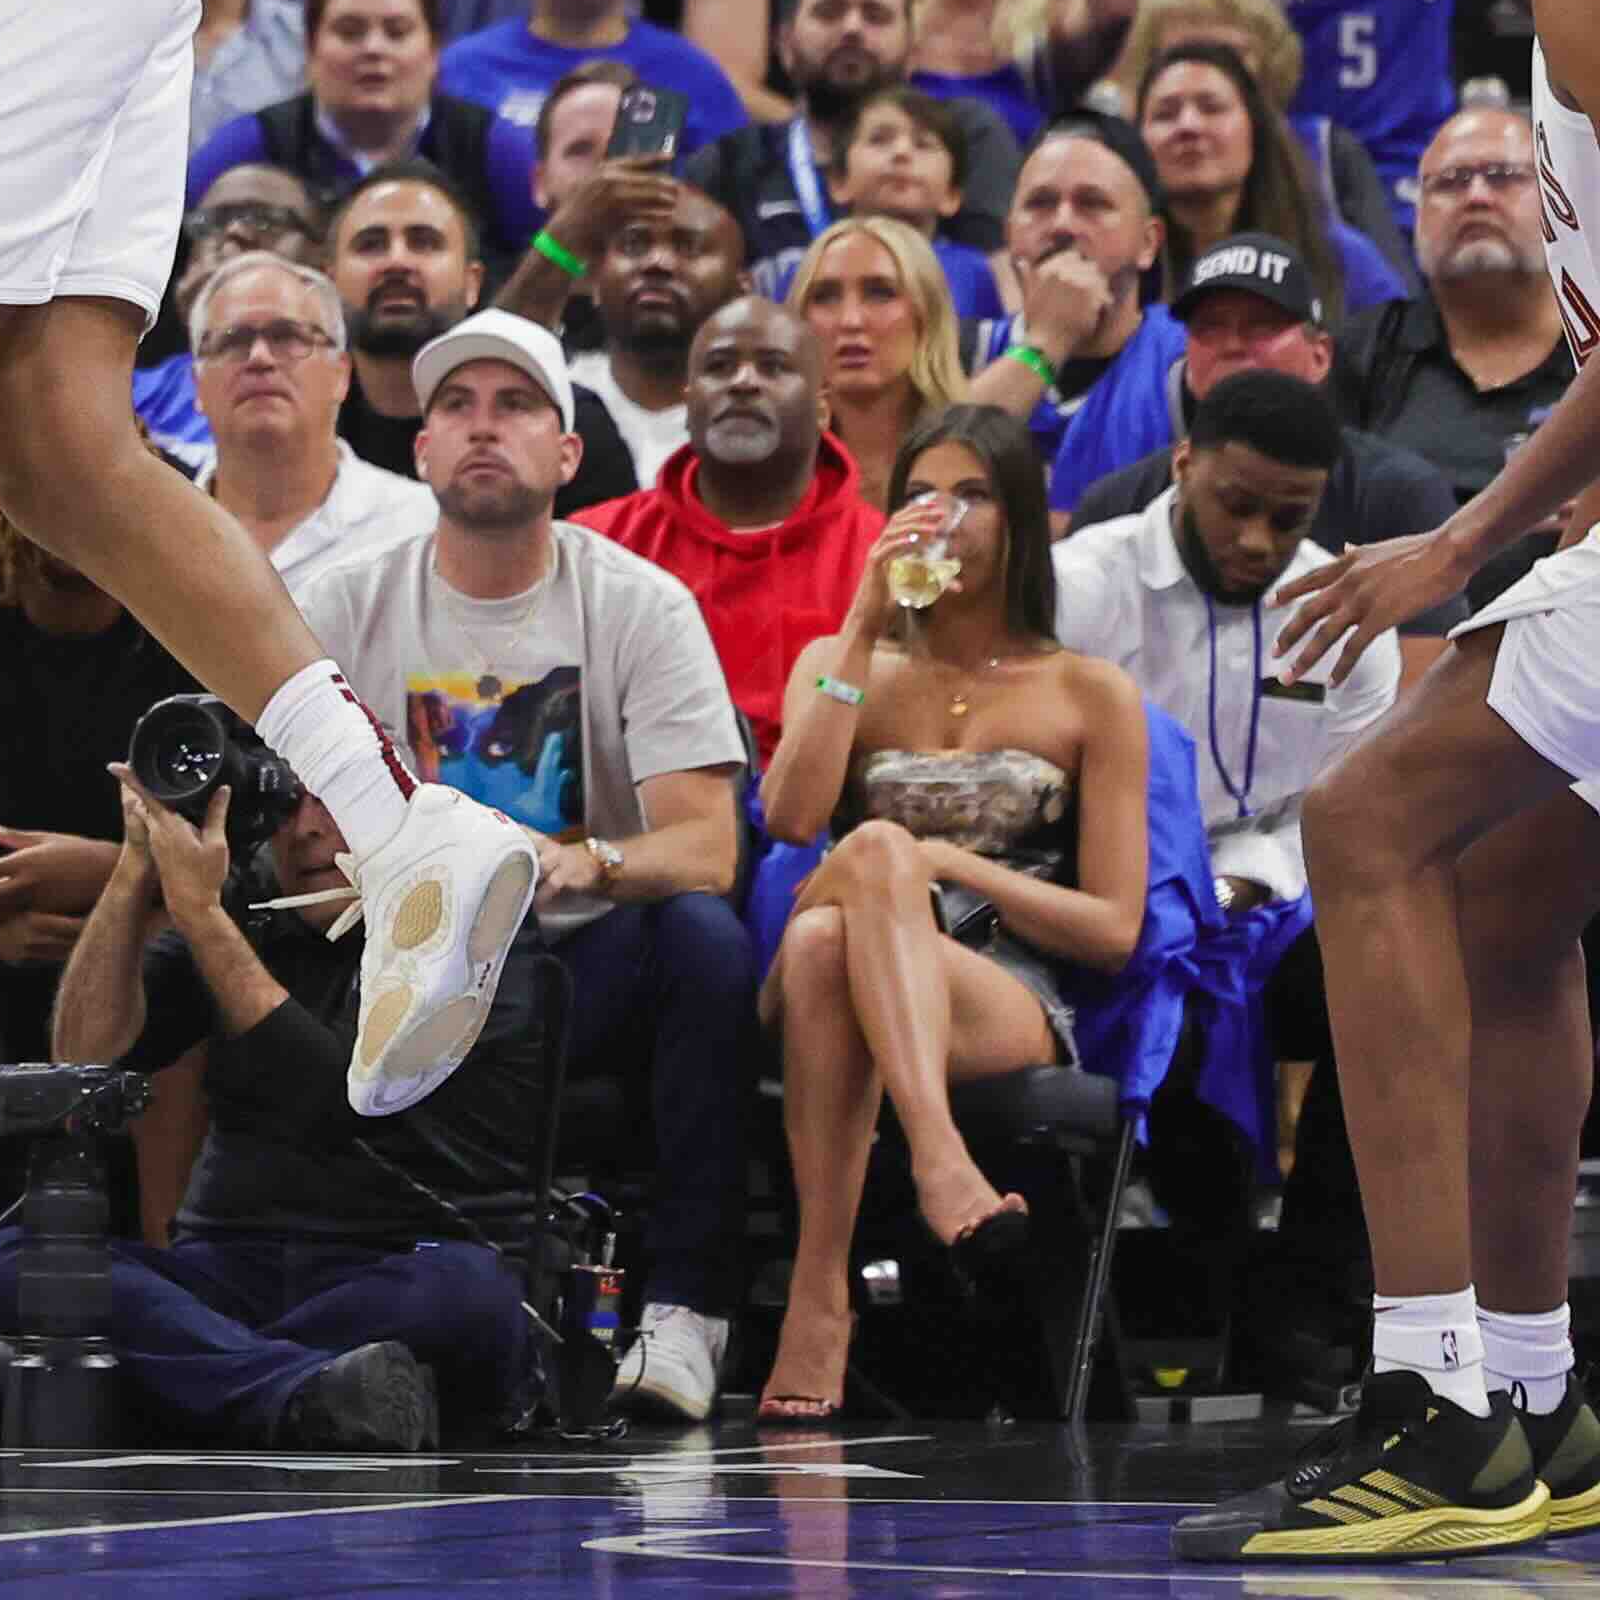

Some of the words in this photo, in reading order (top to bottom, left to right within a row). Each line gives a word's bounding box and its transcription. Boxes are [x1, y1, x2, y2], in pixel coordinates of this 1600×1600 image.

[1337, 11, 1378, 90] 5
[1191, 245, 1259, 286] SEND
[1259, 251, 1292, 285] IT
